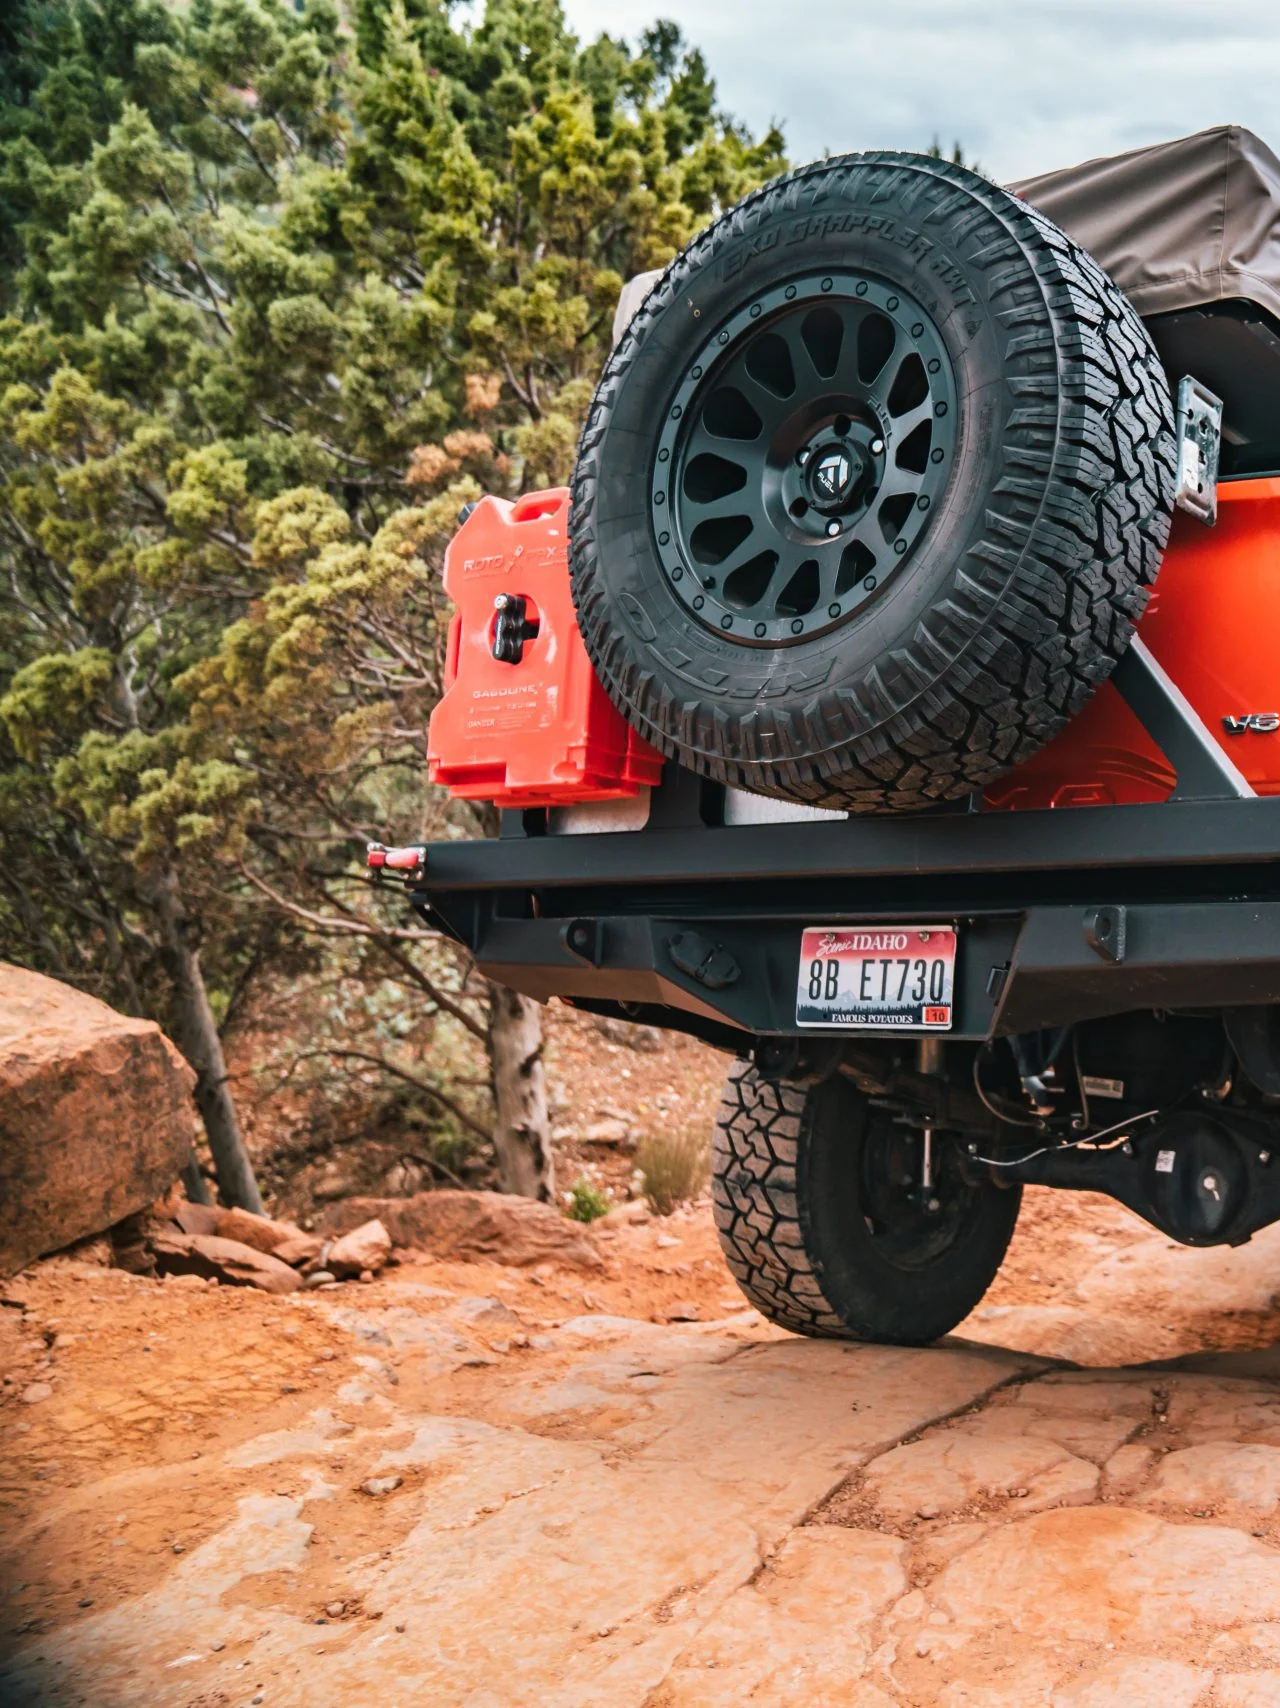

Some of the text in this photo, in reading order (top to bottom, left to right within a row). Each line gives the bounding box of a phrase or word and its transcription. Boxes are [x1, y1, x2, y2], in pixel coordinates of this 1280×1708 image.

[722, 227, 782, 283] EXO
[786, 212, 935, 266] GRAPPLER
[817, 471, 835, 494] FUEL
[463, 555, 504, 572] ROTO
[472, 684, 536, 700] GASOLINE
[1221, 713, 1280, 734] V6
[815, 934, 908, 957] Scenic IDAHO
[808, 959, 946, 1002] 8B ET730
[831, 1013, 867, 1024] FAMOUS
[867, 1013, 914, 1025] POTATOES
[932, 1011, 945, 1023] 10
